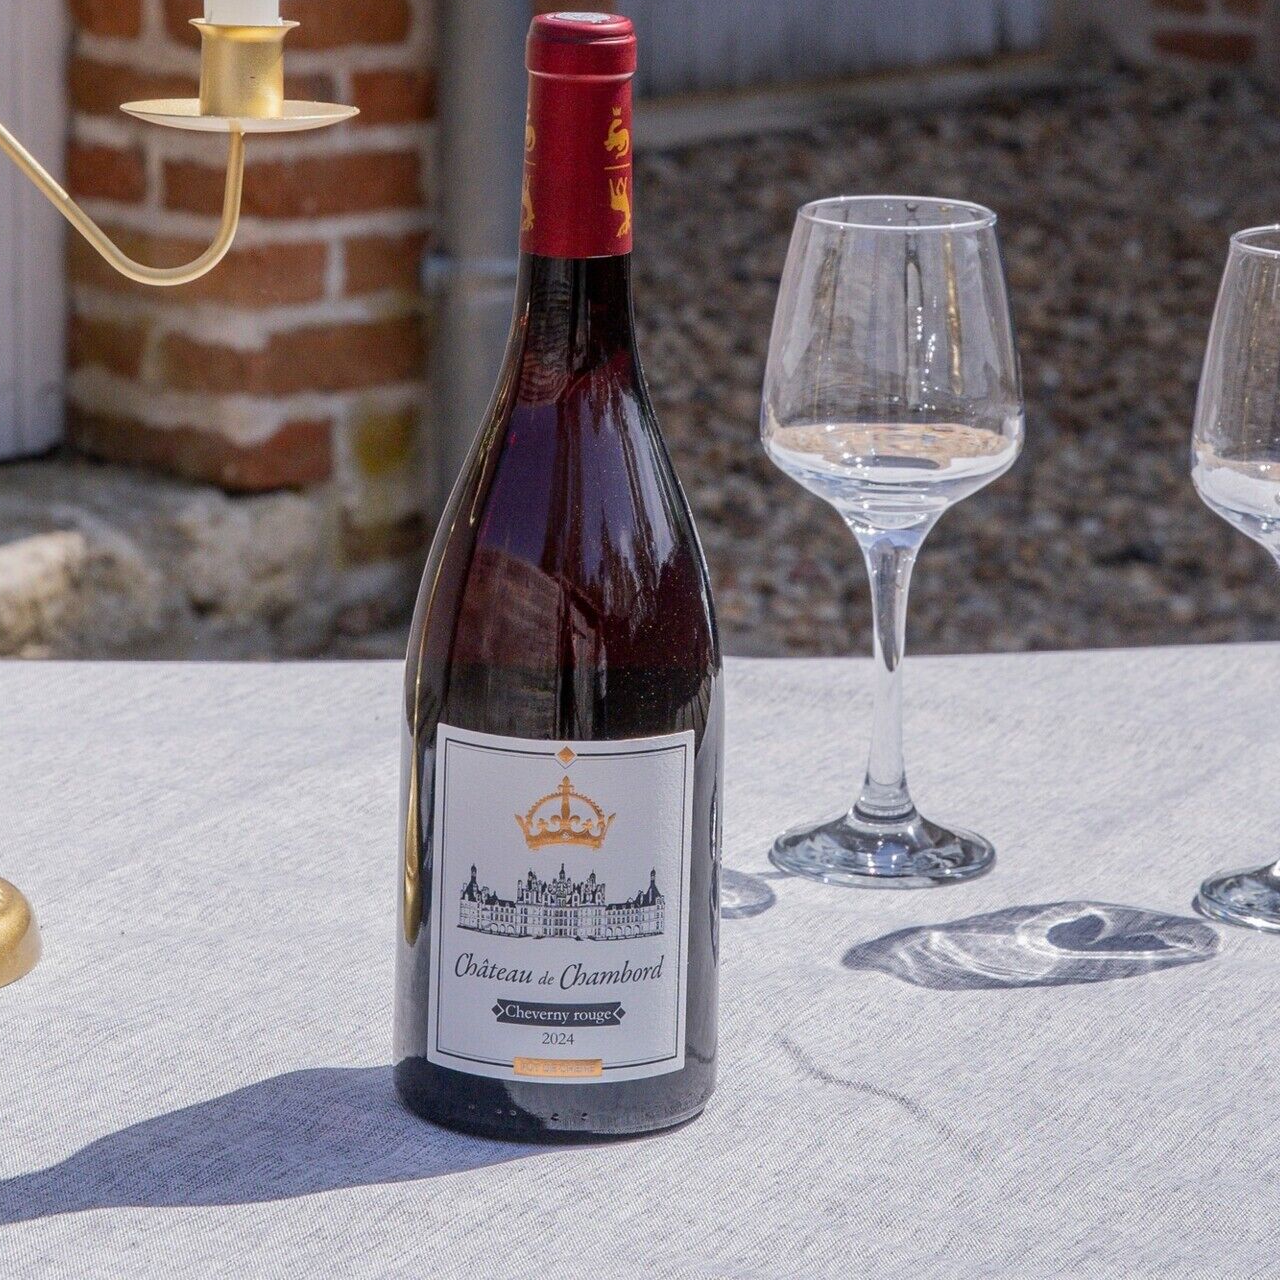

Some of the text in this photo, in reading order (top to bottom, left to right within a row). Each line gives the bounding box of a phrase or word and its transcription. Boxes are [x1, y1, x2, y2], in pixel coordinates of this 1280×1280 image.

[455, 953, 665, 990] Château de Chambord
[505, 1004, 612, 1024] Cheverny rouge
[542, 1032, 575, 1045] 2024
